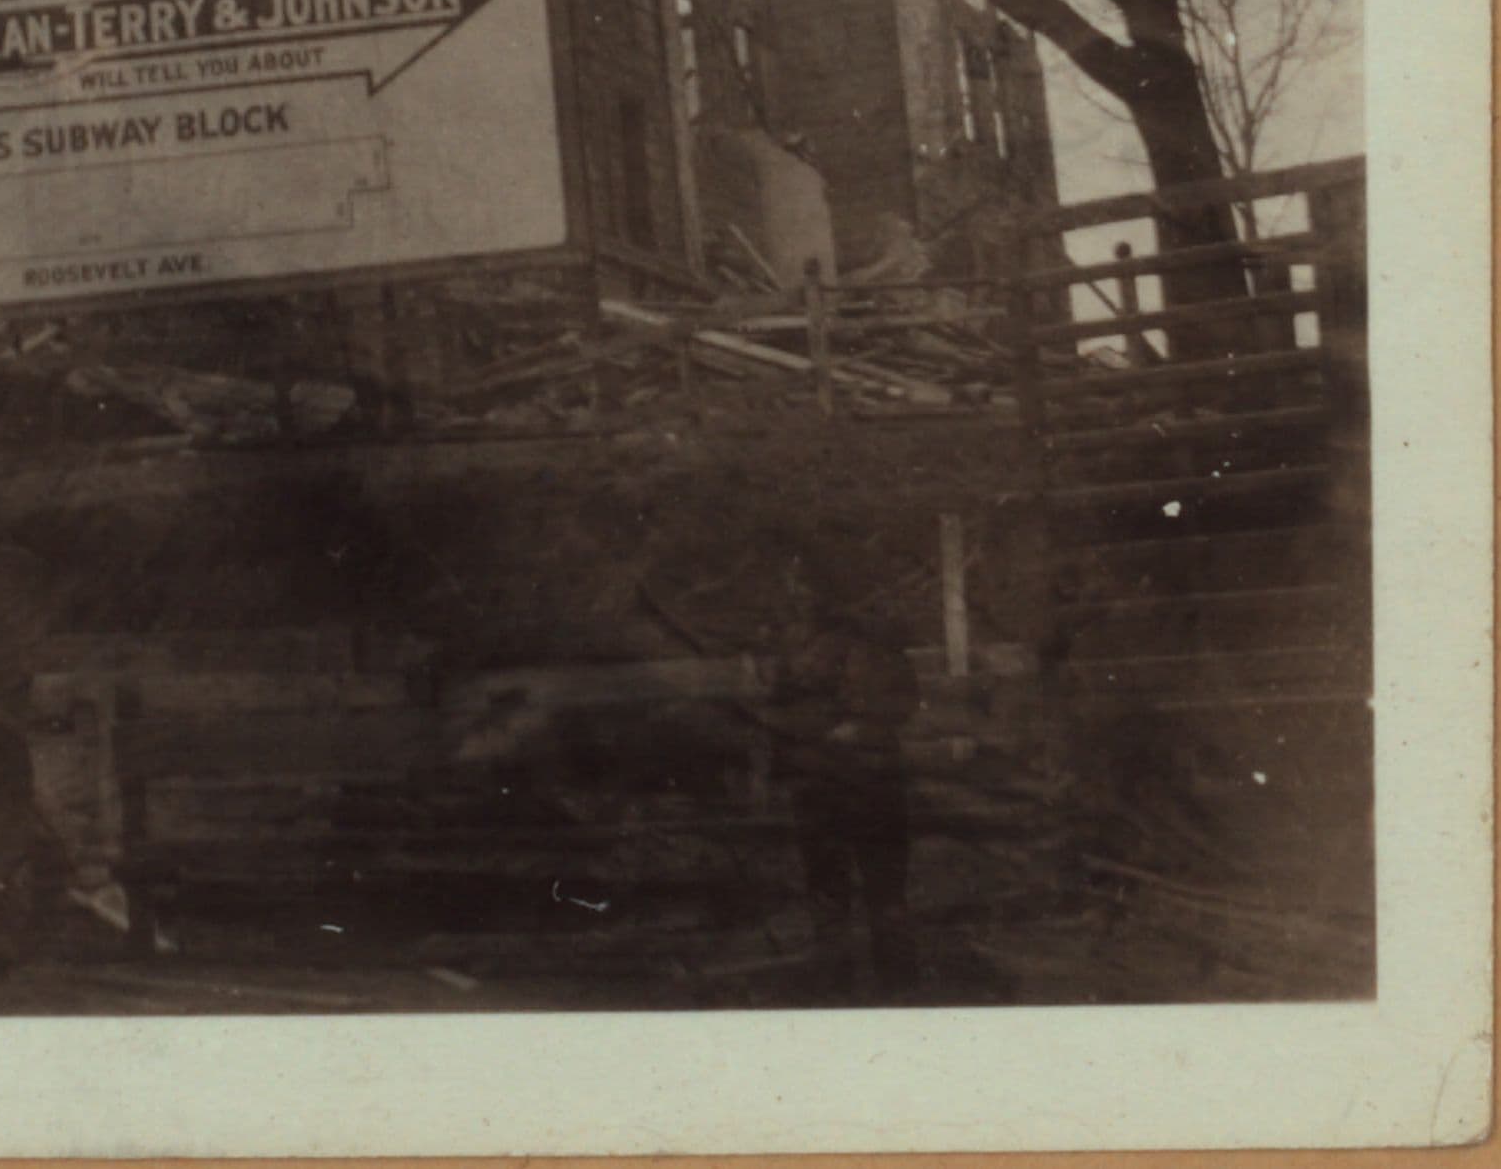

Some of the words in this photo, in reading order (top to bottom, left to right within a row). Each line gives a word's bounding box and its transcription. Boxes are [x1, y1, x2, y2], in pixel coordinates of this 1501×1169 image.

[79, 67, 130, 90] WILL
[135, 62, 185, 83] TELL
[197, 57, 238, 77] YOU
[250, 47, 325, 71] ABOUT
[22, 116, 163, 158] SUBWAY
[176, 103, 291, 142] BLOCK
[24, 257, 148, 286] ROOSEVELT
